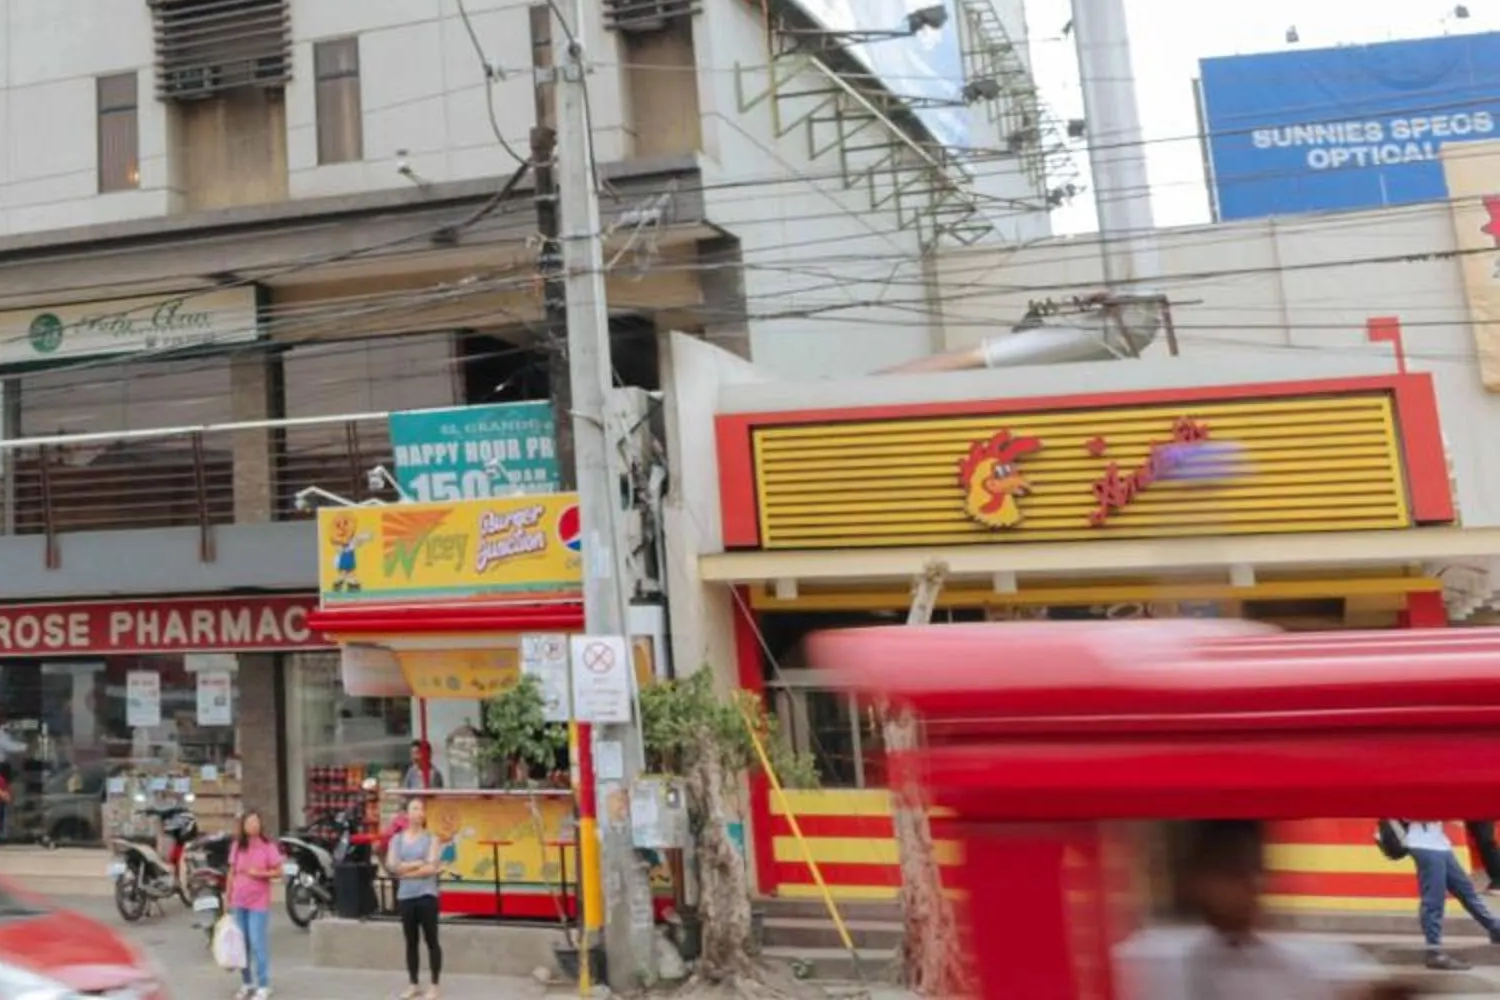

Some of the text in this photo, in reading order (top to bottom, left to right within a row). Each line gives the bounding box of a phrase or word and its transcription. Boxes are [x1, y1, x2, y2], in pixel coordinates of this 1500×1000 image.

[1251, 111, 1494, 149] SUNNIES SPECS
[1307, 142, 1441, 169] OPTICAL
[394, 442, 459, 467] HAPPY
[465, 438, 521, 463] HOUR
[109, 605, 326, 646] PHARMAC
